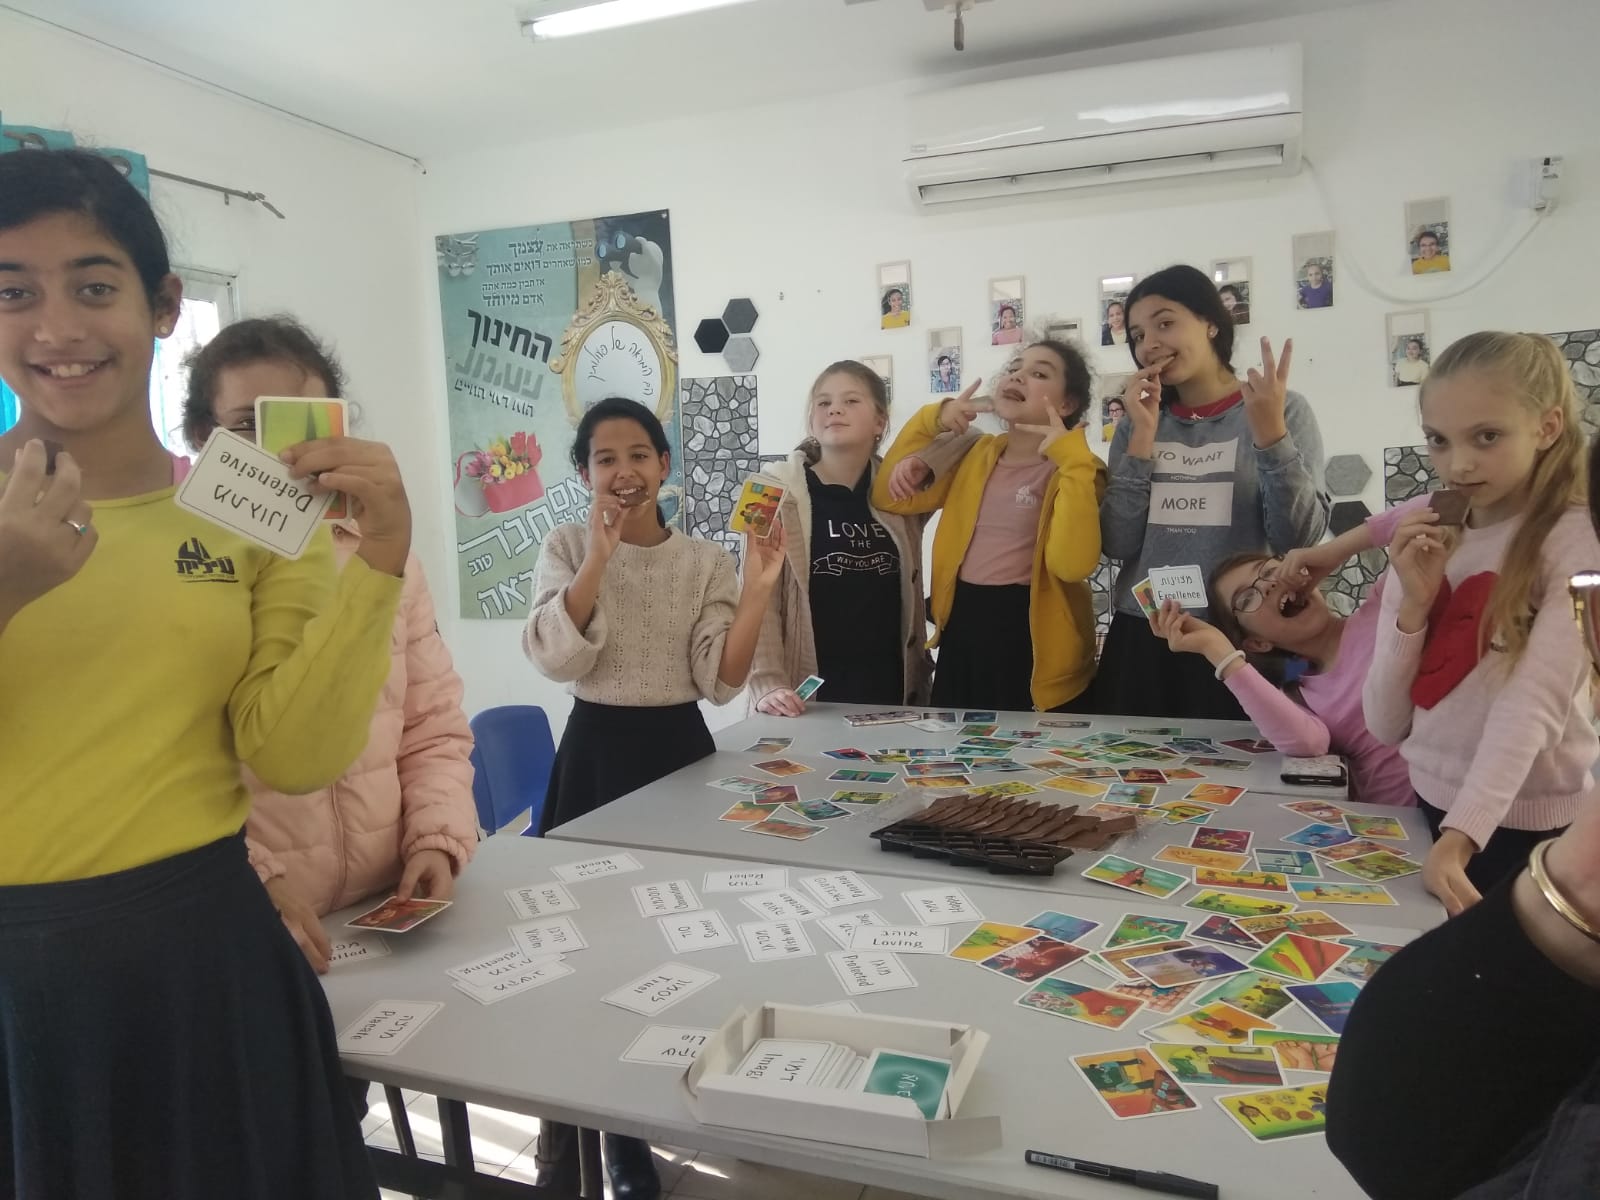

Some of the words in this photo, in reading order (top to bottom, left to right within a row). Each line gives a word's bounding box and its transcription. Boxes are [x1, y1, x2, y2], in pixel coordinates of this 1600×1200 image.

[508, 239, 544, 258] עצמך
[486, 263, 513, 276] אותך
[514, 260, 541, 273] רואים
[522, 294, 545, 306] אדם
[468, 309, 553, 363] החינוך
[611, 326, 626, 351] של
[1158, 450, 1177, 461] TO
[1182, 450, 1225, 466] WANT
[219, 450, 314, 513] Defensive
[213, 484, 288, 533] מתגונן
[1161, 497, 1207, 511] MORE
[828, 519, 887, 538] LOVE
[1183, 527, 1198, 535] YOU
[849, 540, 872, 549] THE
[836, 556, 854, 566] WAY
[871, 555, 886, 566] ARE
[1158, 590, 1201, 601] Excellence
[872, 938, 924, 949] Loving
[842, 954, 875, 987] Protected
[634, 975, 674, 994] Trust
[350, 1010, 397, 1041] Placate
[681, 1034, 707, 1046] Lie
